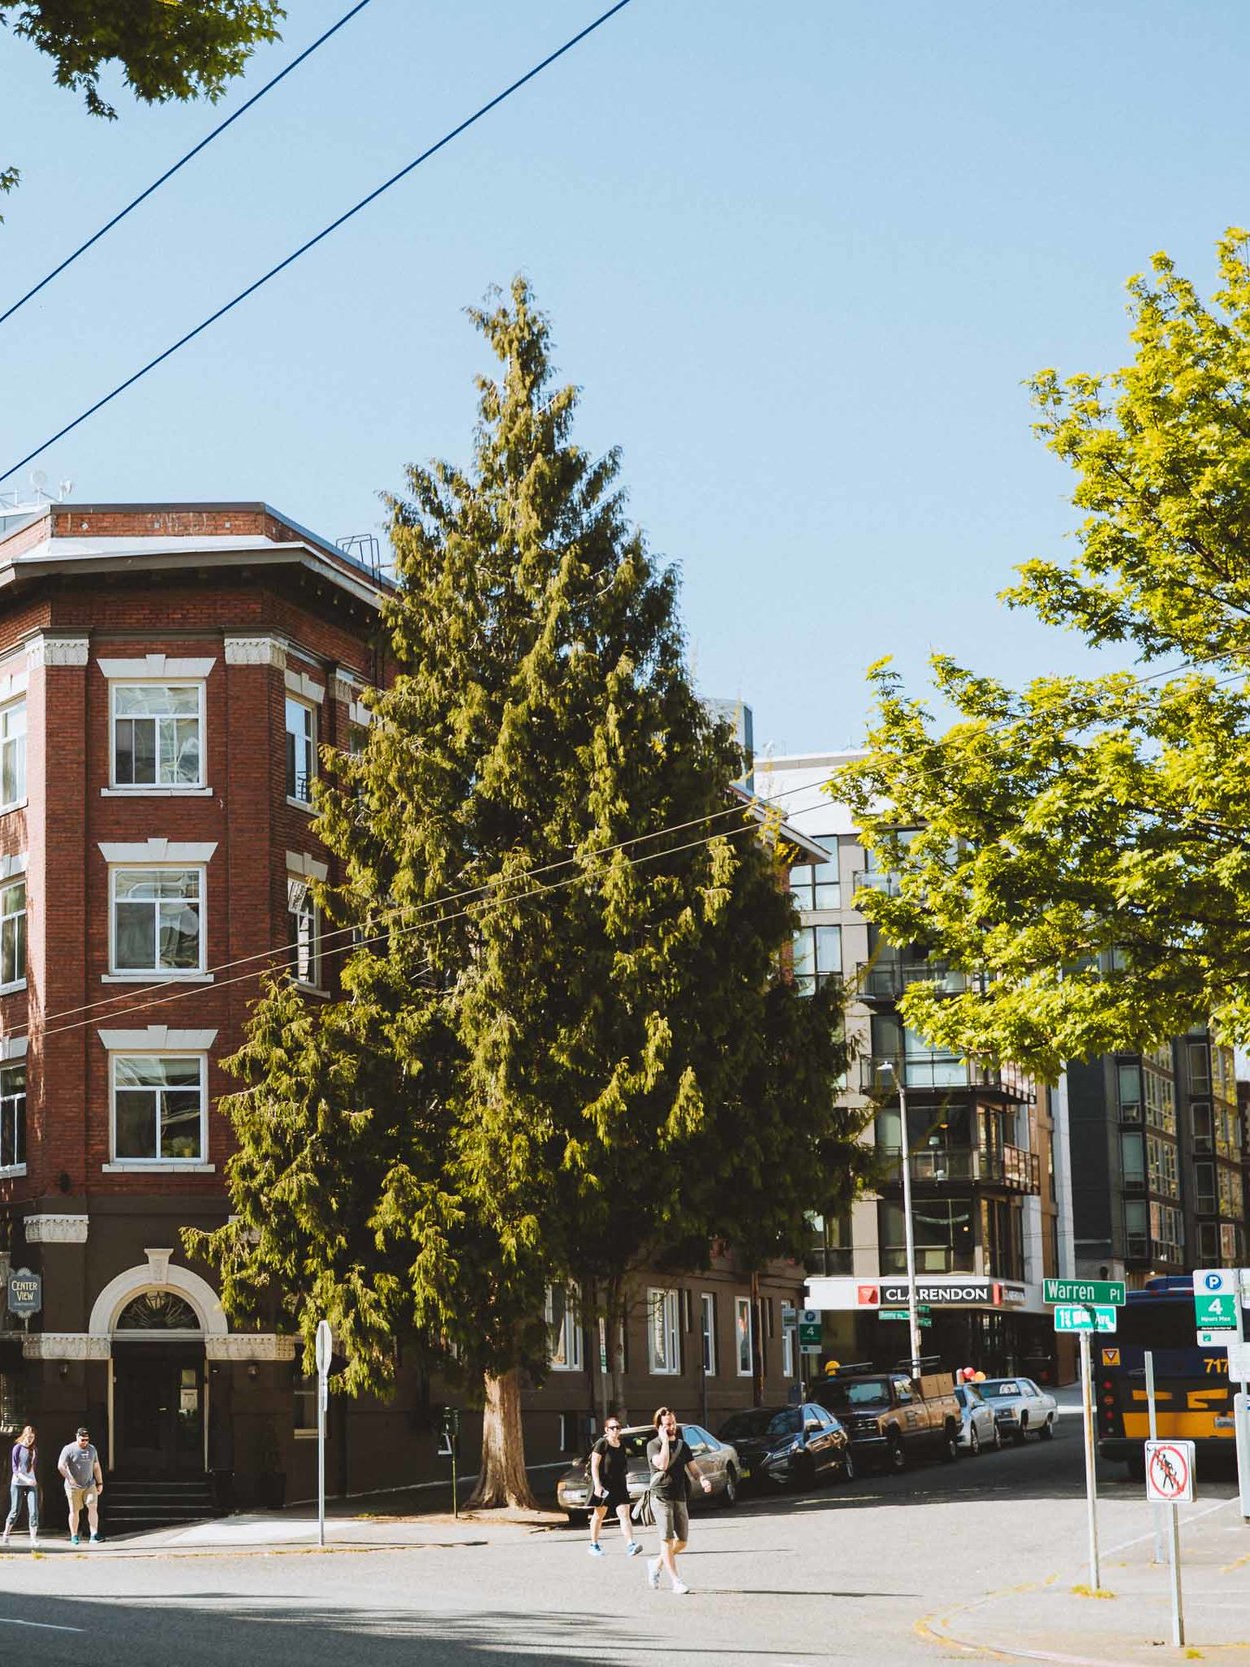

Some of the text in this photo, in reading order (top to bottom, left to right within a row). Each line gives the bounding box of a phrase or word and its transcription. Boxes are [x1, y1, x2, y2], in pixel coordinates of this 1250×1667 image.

[11, 1280, 38, 1291] CENTER
[1048, 1281, 1121, 1301] Warren Pl
[16, 1291, 34, 1302] VIEW
[1208, 1298, 1223, 1315] 4
[806, 1326, 815, 1336] 4
